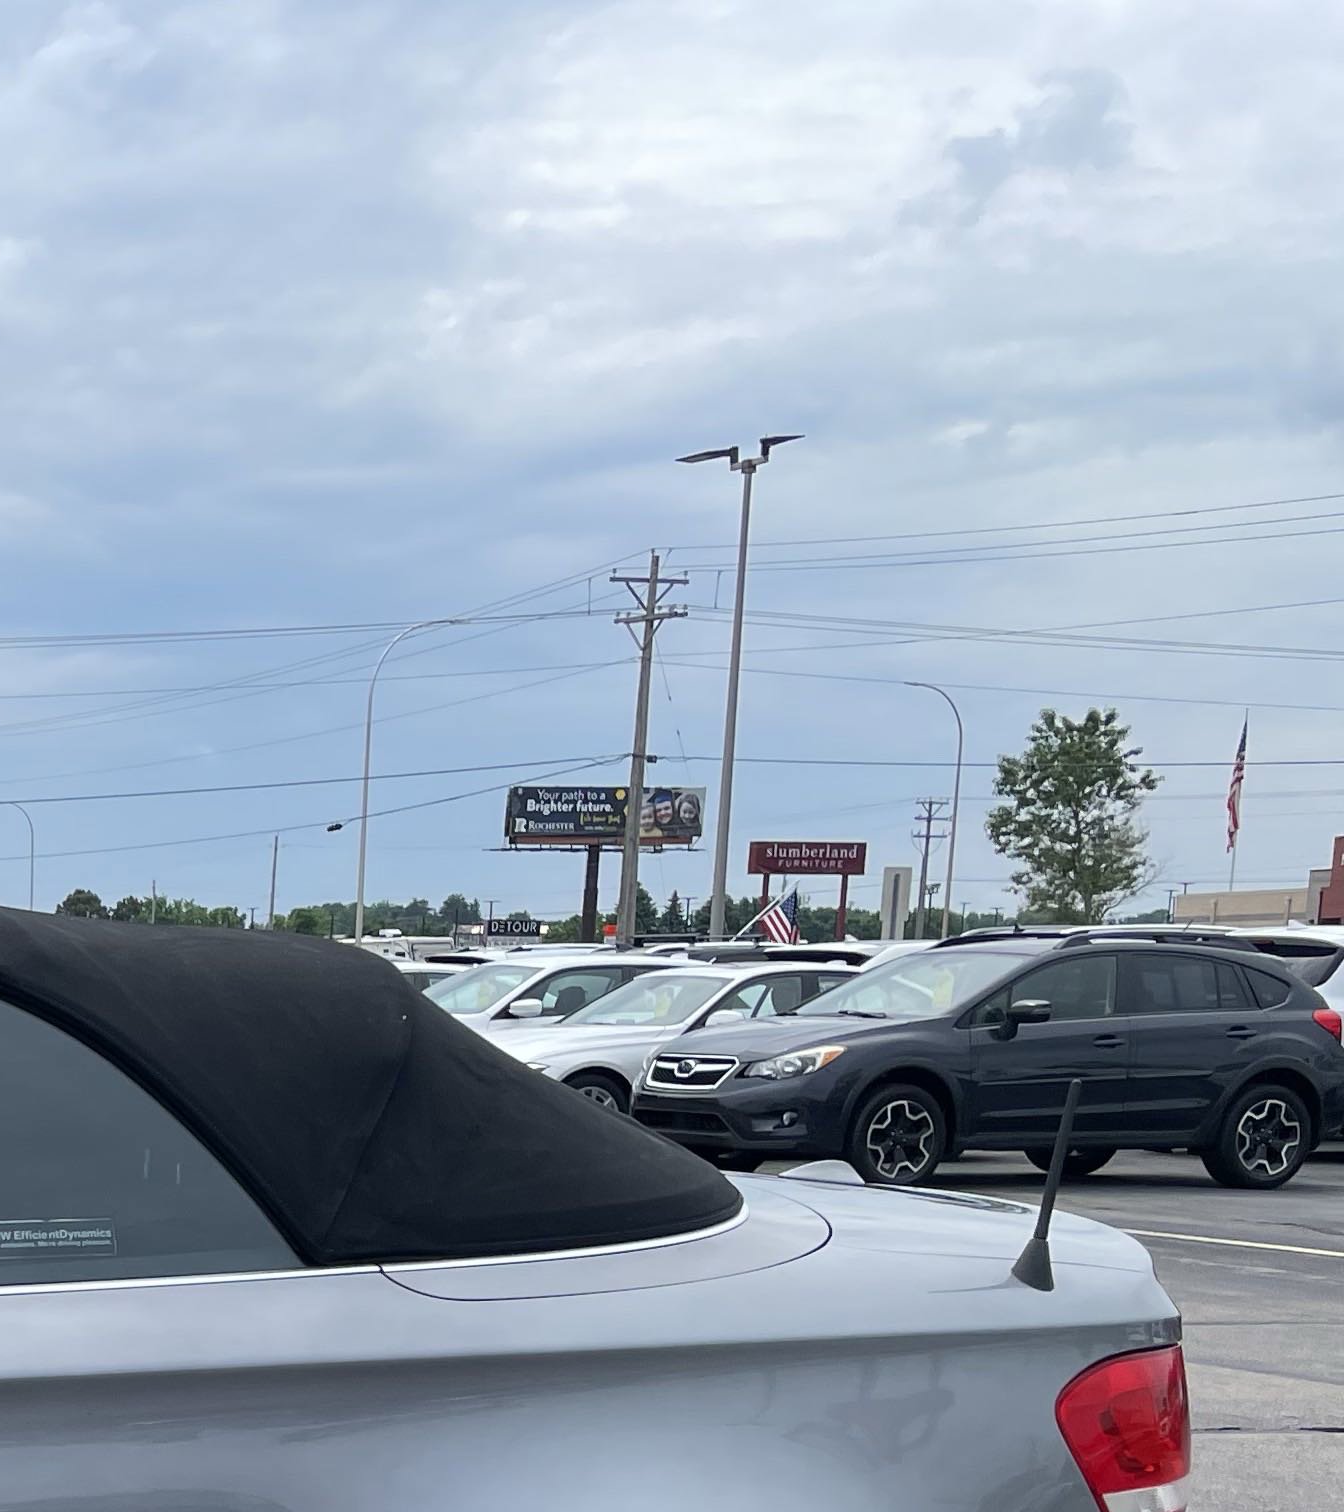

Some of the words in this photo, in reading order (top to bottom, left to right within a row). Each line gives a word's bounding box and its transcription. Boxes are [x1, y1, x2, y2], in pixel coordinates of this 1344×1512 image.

[537, 789, 560, 800] Your
[562, 789, 585, 802] path
[587, 789, 598, 800] to
[599, 792, 606, 800] a
[526, 798, 574, 816] Brighter
[575, 799, 614, 813] future.
[766, 843, 858, 858] slumberland
[778, 859, 844, 868] FURNITURE
[491, 920, 537, 933] DETOUR
[13, 1228, 112, 1241] EfficientDynamics
